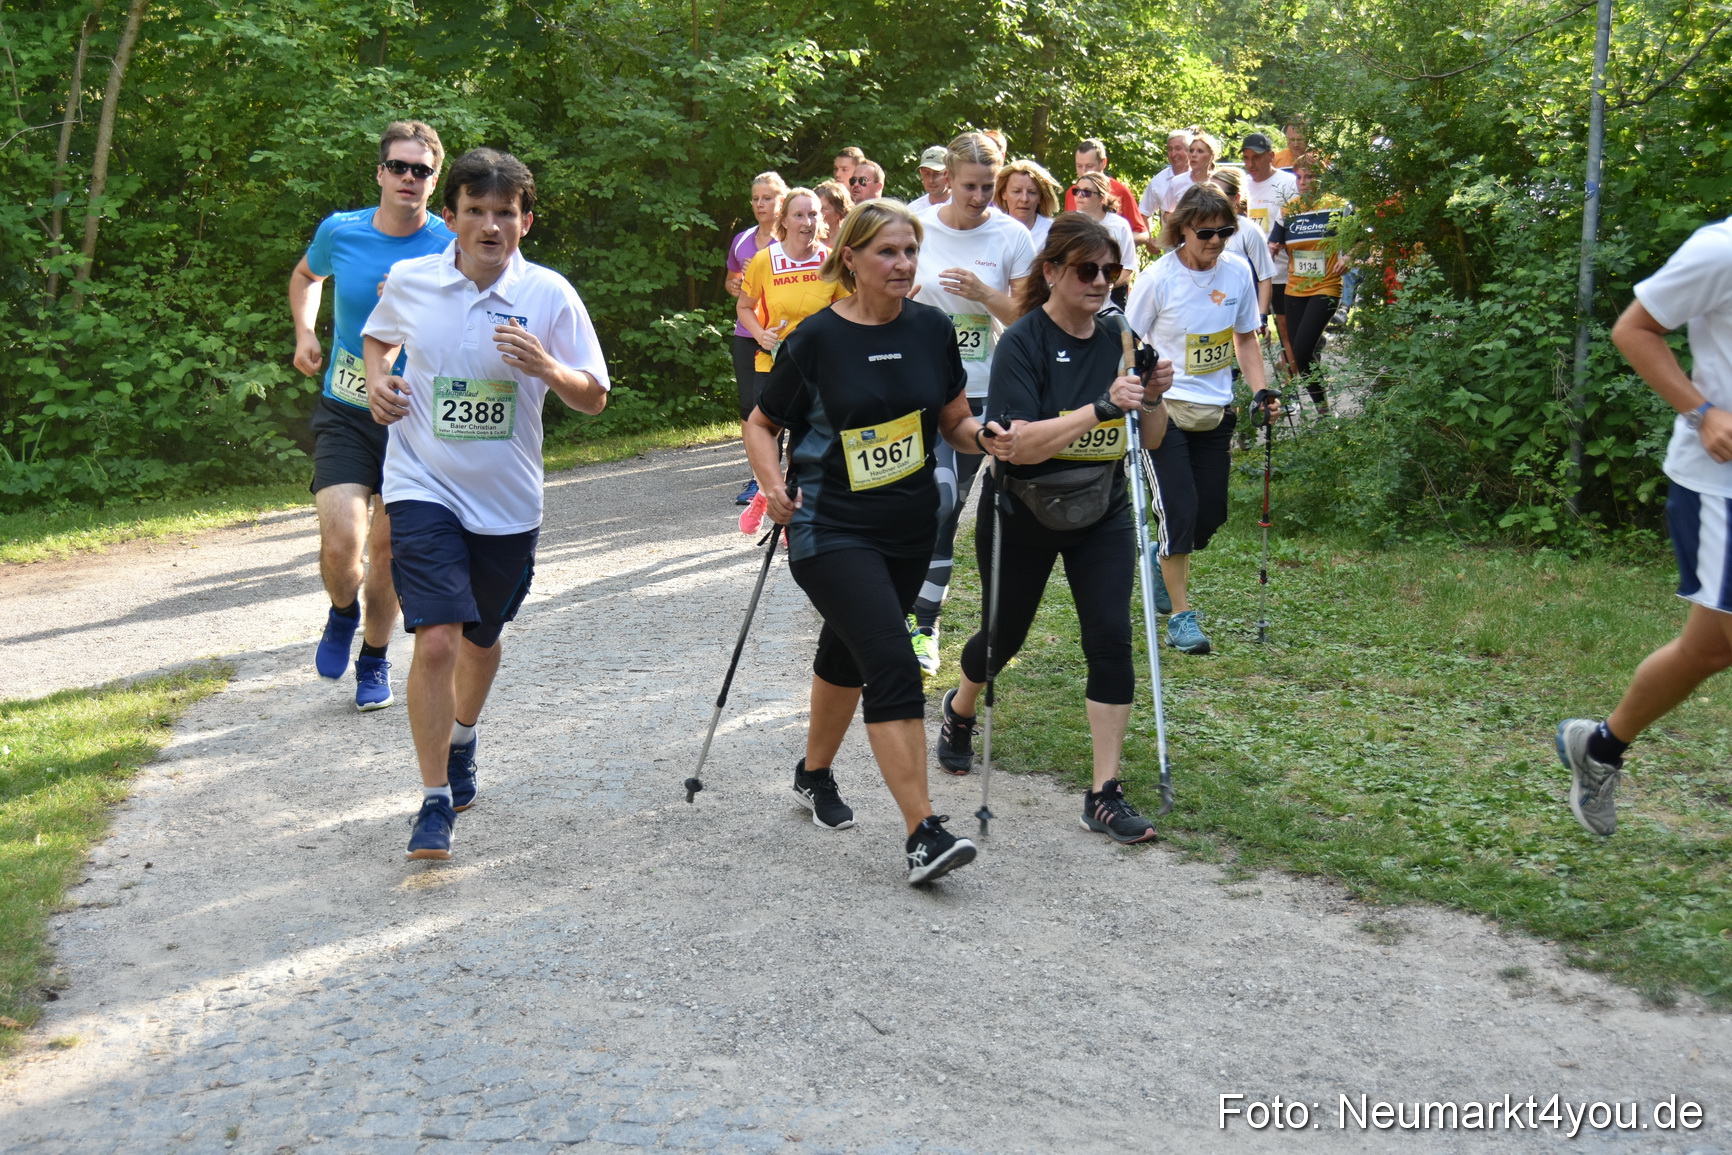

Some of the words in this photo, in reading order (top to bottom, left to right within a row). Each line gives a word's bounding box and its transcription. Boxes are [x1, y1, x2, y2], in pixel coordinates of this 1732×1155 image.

[975, 259, 997, 268] Charlotte
[1299, 261, 1317, 271] 9134
[773, 275, 799, 286] MAX
[1193, 342, 1230, 364] 1337
[441, 399, 505, 424] 2388
[857, 435, 914, 472] 1967
